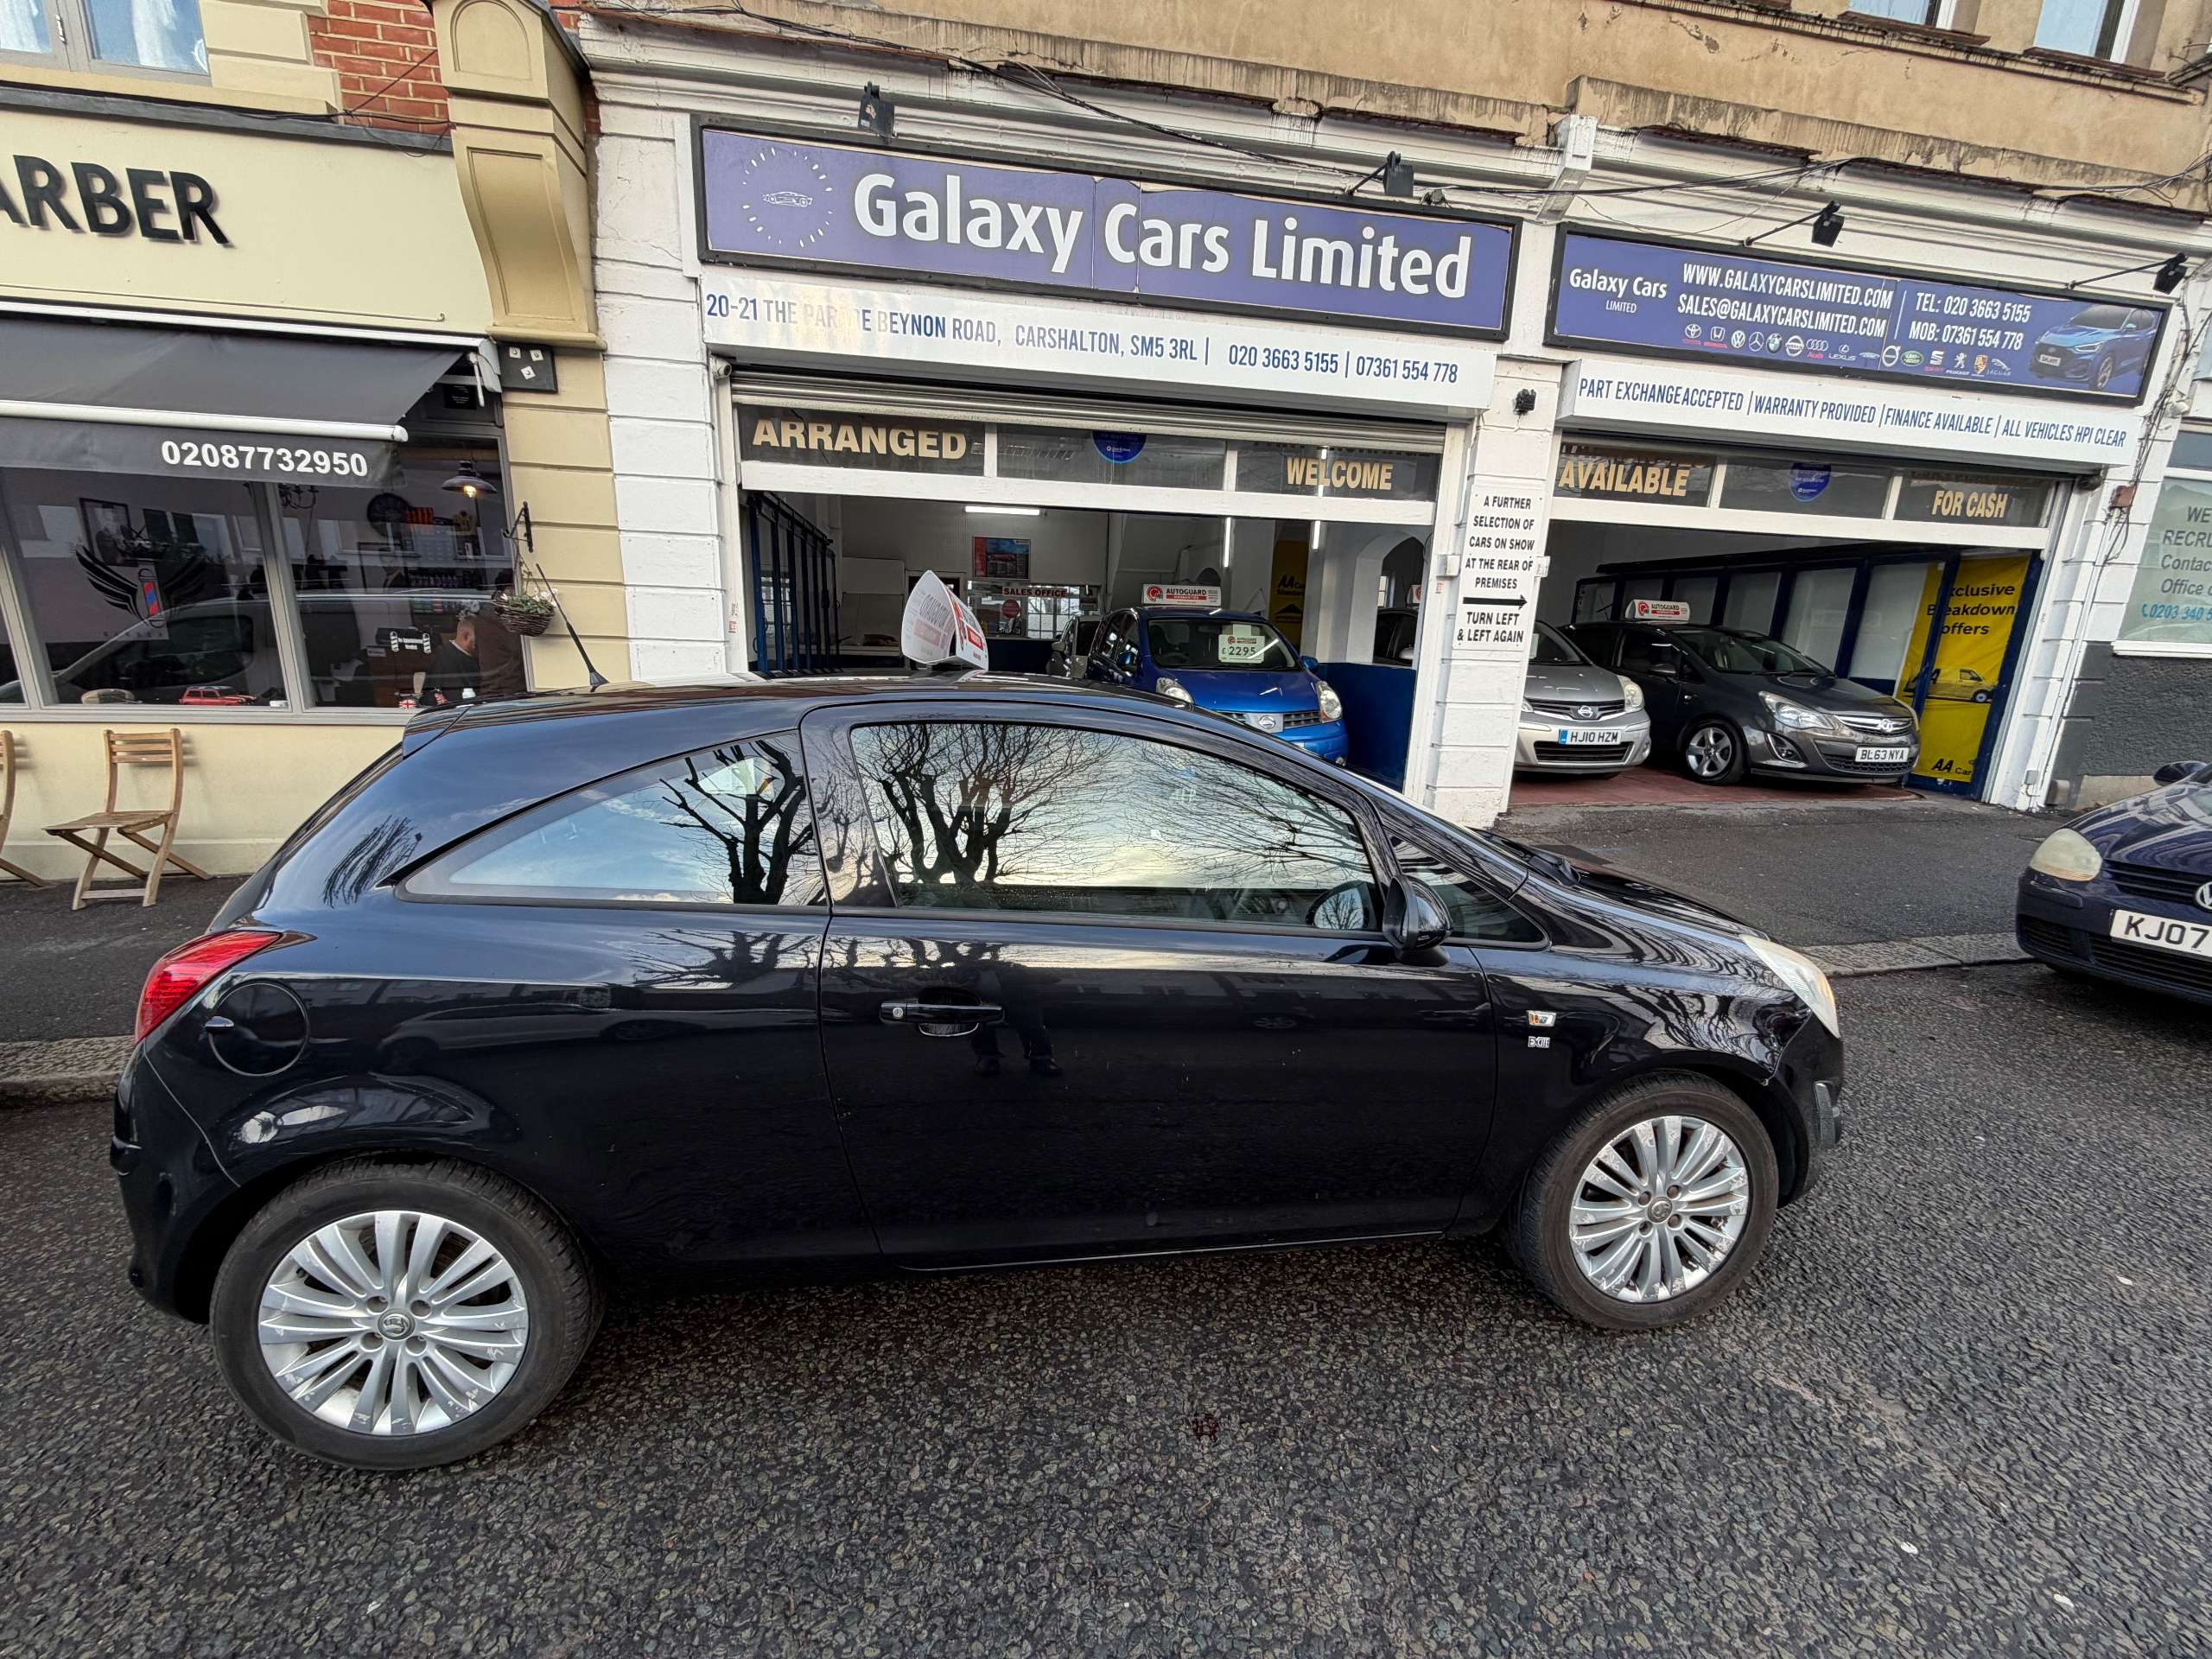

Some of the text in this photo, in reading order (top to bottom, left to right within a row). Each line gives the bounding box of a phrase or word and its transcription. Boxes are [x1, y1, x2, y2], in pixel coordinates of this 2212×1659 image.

[854, 173, 1472, 299] Galaxy Cars Limited
[1569, 269, 1668, 300] Galaxy Cars
[1683, 263, 1894, 310] WWW.GALAXYCARSLIMITED.COM
[1605, 300, 1637, 314] LIMITED
[1915, 292, 2031, 324] TEL: 020 3663 5155
[1677, 293, 1887, 338] SALES@GALAXYCARSLIMITED.COM
[706, 294, 759, 321] 20-21
[763, 299, 798, 325] THE
[877, 309, 946, 339] BEYNON
[952, 318, 1001, 346] ROAD,
[1015, 324, 1124, 358] CARSHALTON,
[1130, 334, 1165, 359] SM5
[1168, 338, 1198, 361] 3RL
[1229, 344, 1258, 367] 020
[1262, 348, 1300, 372] 3663
[1304, 352, 1339, 374] 5155
[1356, 355, 1398, 379] 07361
[1402, 359, 1429, 382] 554
[1433, 362, 1459, 385] 778
[1909, 321, 2024, 352] MOB: 07361 554 778
[1579, 378, 2126, 448] PART EXCHANGE ACCEPTED WARRANTY PROVIDED FINANCE AVAILABLE ALL VEHICLES HPI CLEAR
[753, 419, 967, 461] ARRANGED
[162, 440, 368, 478] 02087732950
[1287, 456, 1394, 491] WELCOME
[1558, 461, 1691, 497] AVAILABLE
[1484, 496, 1531, 509] A FURTHER
[1931, 490, 2009, 518] FOR CASH
[1473, 516, 1535, 530] SELECTION OF
[1469, 536, 1535, 550] CARS ON SHOW
[1465, 557, 1534, 571] AT THE REAR OF
[1475, 577, 1517, 589] PREMISES
[2161, 578, 2204, 596] Office
[1003, 588, 1066, 598] SALES OFFICE
[1948, 584, 2015, 597] xclusive
[1927, 604, 2018, 616] Beakdown
[2149, 604, 2179, 620] 0203
[1466, 612, 1520, 626] TURN LEFT
[1457, 629, 1523, 643] & LEFT AGAIN
[1942, 623, 1990, 635] offers
[1229, 645, 1255, 657] 2295
[1571, 732, 1618, 742] HJ10 HZM
[1860, 750, 1904, 760] BL63 NYA
[1932, 758, 1954, 772] AA
[2124, 916, 2209, 949] KJ07
[1528, 1036, 1550, 1048] EXCITE
